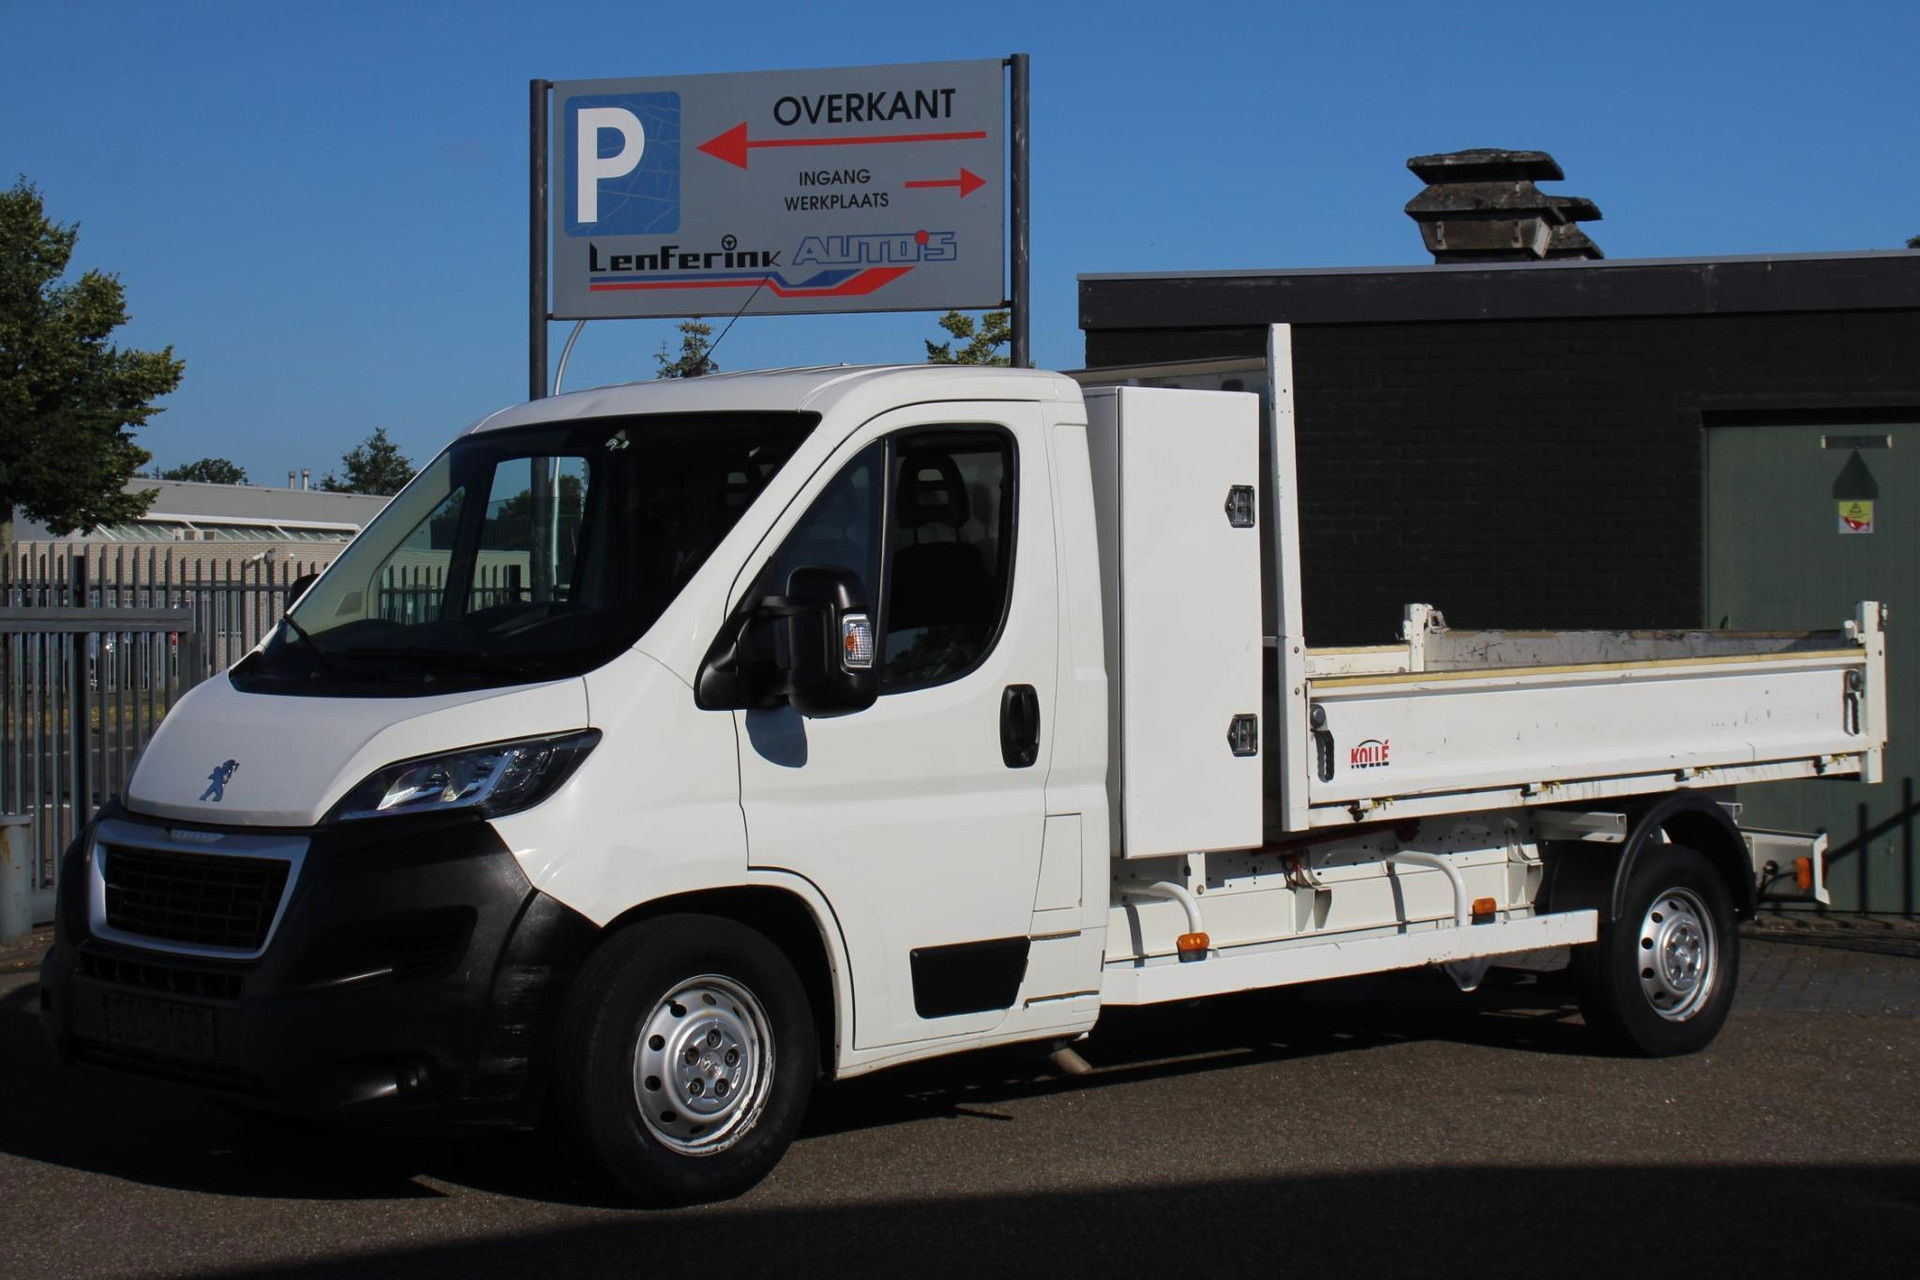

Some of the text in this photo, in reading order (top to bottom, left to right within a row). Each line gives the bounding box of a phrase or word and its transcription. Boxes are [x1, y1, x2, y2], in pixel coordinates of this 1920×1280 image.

[773, 88, 956, 126] OVERKANT
[577, 107, 645, 223] P
[799, 169, 871, 186] INGANG
[784, 192, 890, 212] WERKPLAATS
